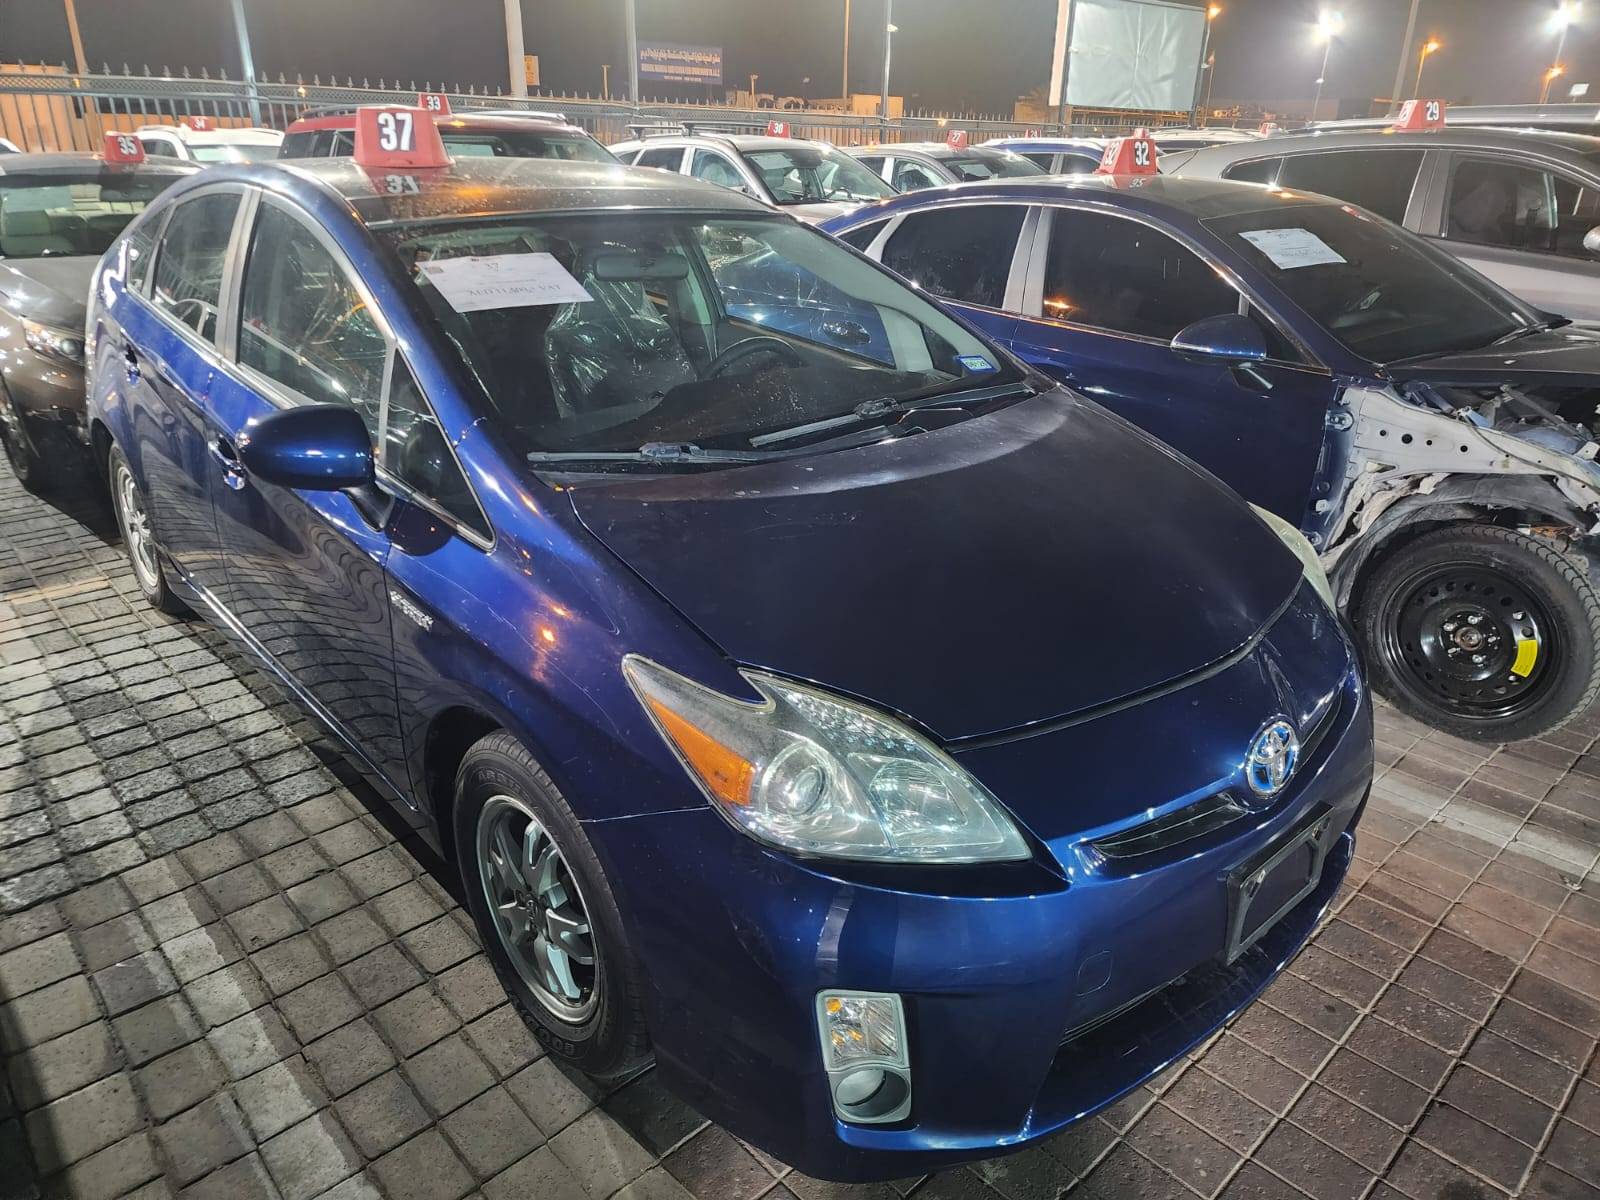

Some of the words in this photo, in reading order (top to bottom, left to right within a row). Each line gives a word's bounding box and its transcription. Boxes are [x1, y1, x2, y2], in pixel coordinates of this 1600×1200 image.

[426, 95, 441, 111] 33
[1426, 101, 1440, 121] 29
[377, 112, 413, 152] 37
[951, 132, 961, 143] 27
[117, 136, 138, 155] 35
[1134, 140, 1150, 166] 32
